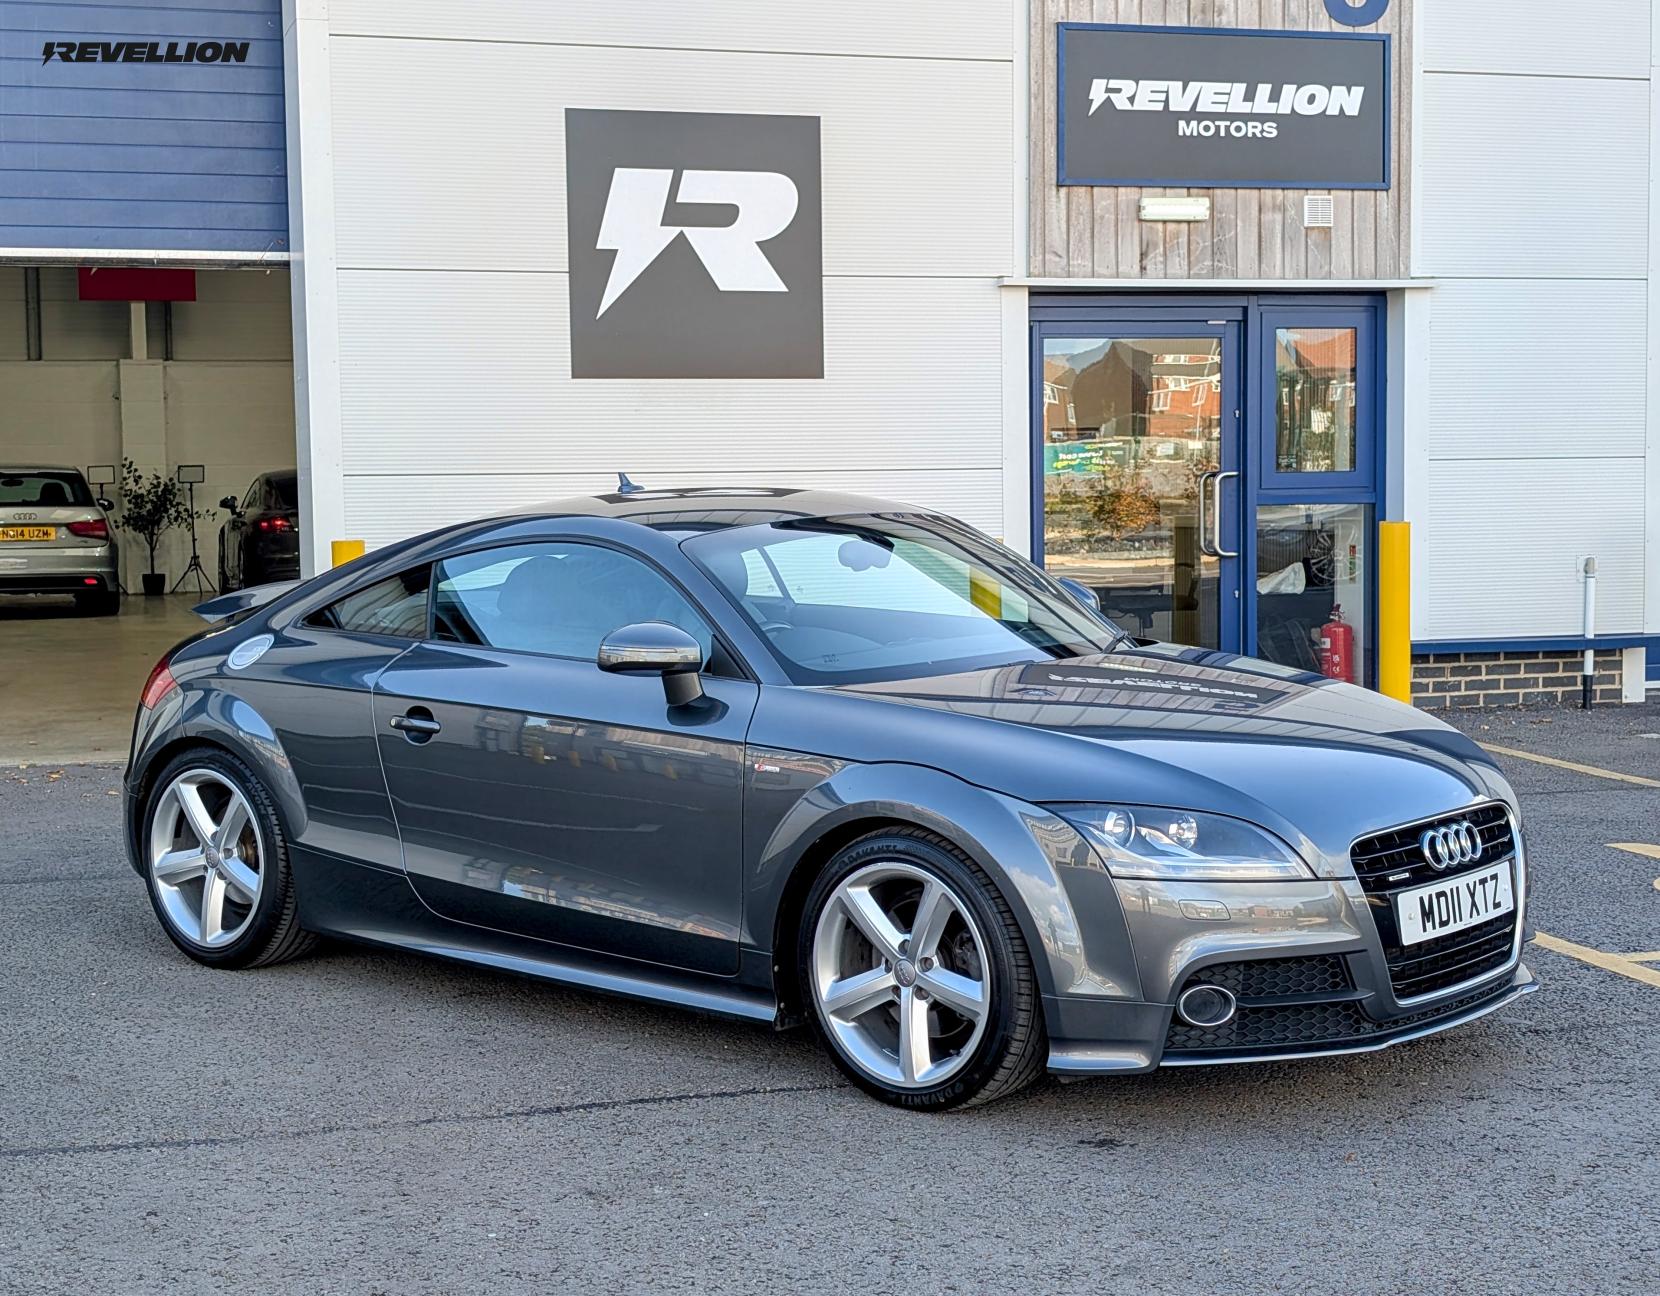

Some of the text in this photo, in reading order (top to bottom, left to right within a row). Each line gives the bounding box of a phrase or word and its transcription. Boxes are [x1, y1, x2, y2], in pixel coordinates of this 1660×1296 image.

[1088, 78, 1365, 117] REVELLION
[1178, 119, 1279, 139] MOTORS
[2, 528, 49, 539] NG14 UZM
[1418, 872, 1502, 934] MD11 XTZ
